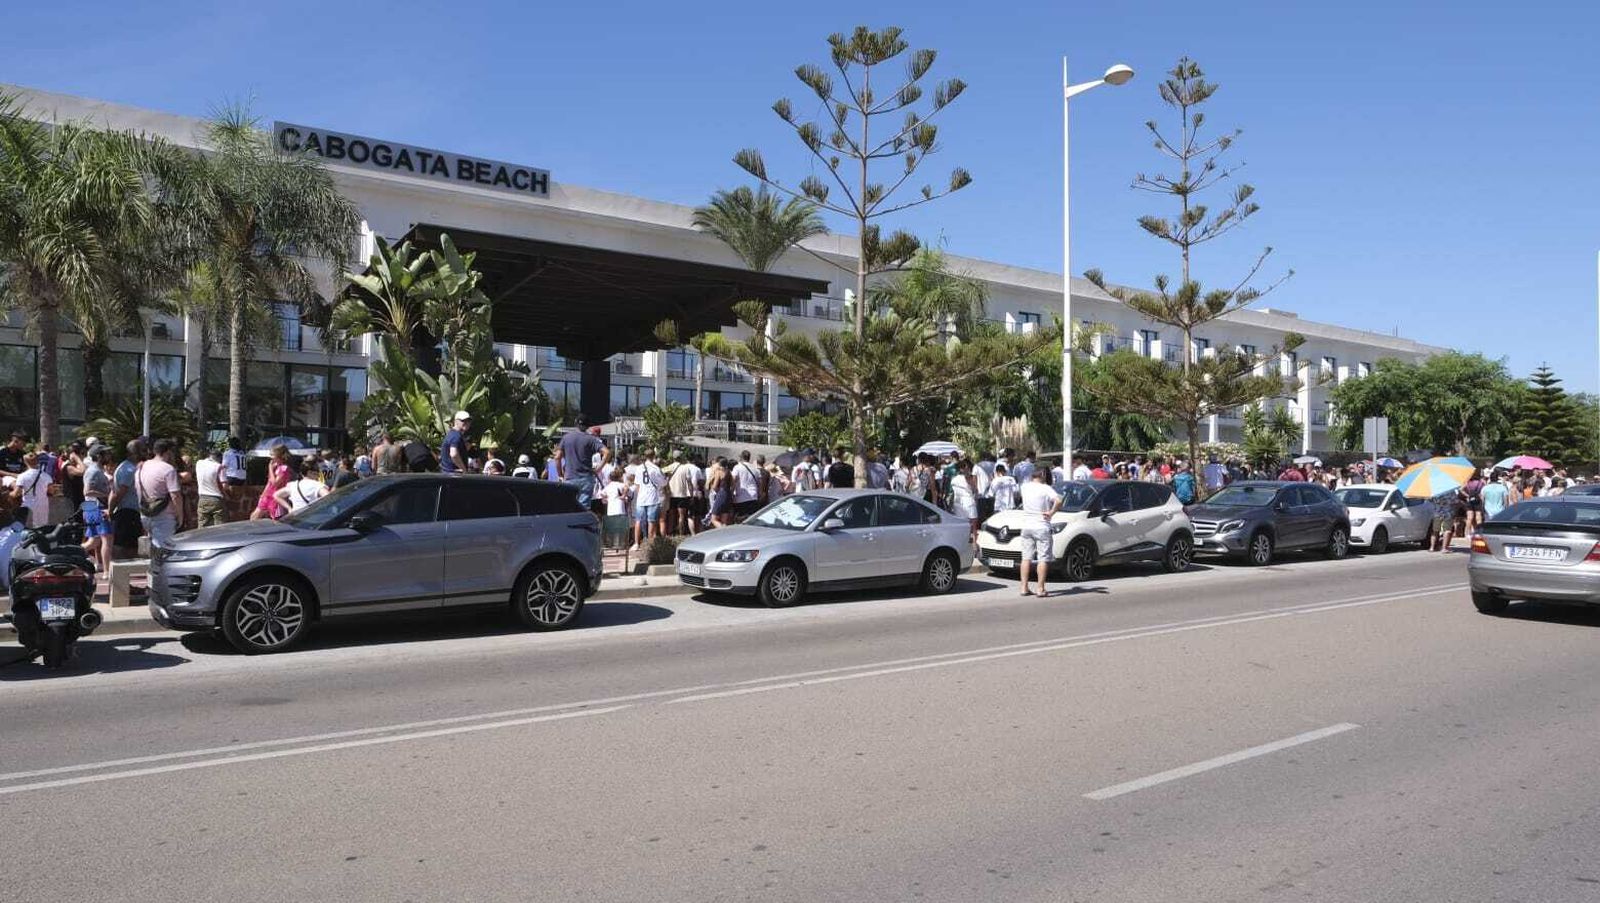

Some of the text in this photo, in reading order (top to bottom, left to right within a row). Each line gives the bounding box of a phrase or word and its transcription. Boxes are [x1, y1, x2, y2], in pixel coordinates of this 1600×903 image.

[279, 127, 548, 194] CABOGATA BEACH
[235, 454, 246, 470] 10
